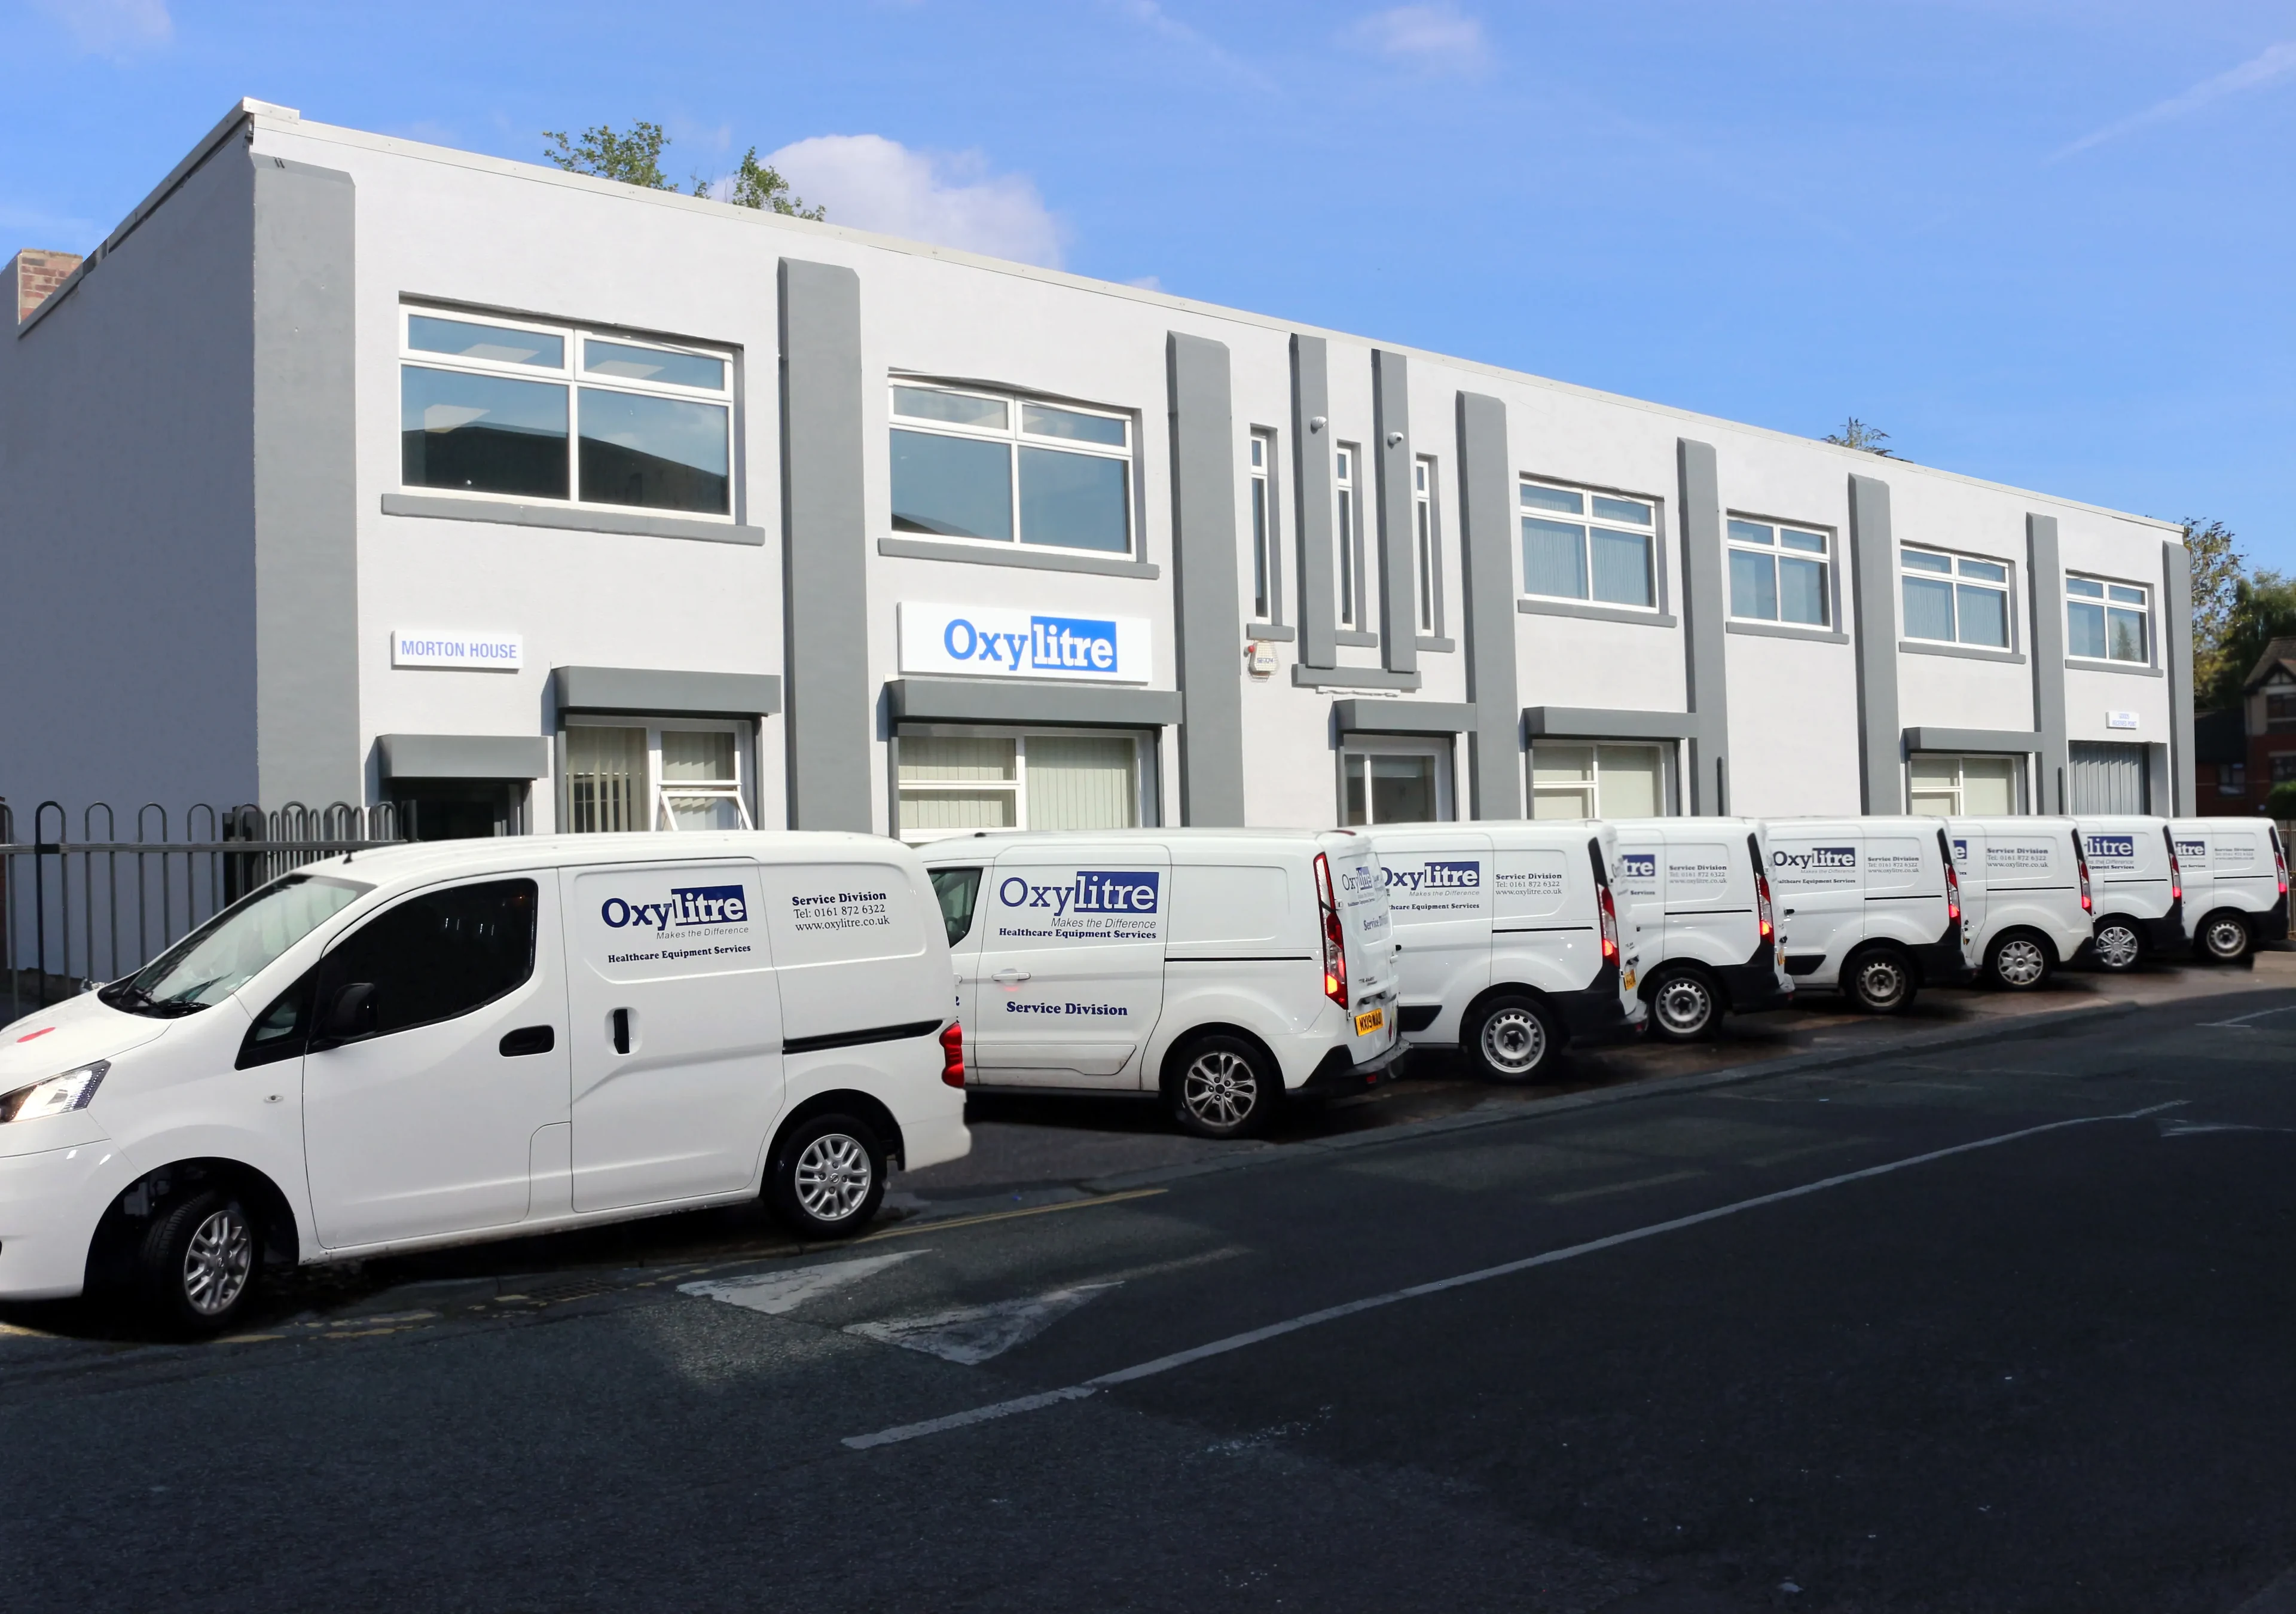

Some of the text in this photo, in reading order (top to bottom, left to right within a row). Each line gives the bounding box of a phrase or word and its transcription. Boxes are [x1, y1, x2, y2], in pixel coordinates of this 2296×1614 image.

[401, 640, 517, 659] MORTON HOUSE
[944, 619, 1113, 671] Oxylitre
[2086, 837, 2132, 855] litre
[1773, 850, 1854, 869] Oxylitre
[792, 891, 887, 906] Service Division
[1000, 876, 1155, 916] Oxylitre
[602, 892, 744, 931] Oxylitre
[793, 904, 885, 919] Tel: 0161 872 6322
[795, 915, 890, 931] www.oxylitre.co.uk
[1051, 918, 1156, 928] Makes the Difference
[657, 931, 685, 940] Makes
[704, 927, 749, 936] Difference
[999, 928, 1156, 939] Healthcare Equipment Services
[608, 945, 751, 963] Healthcare Equipment Services
[1006, 1001, 1128, 1016] Service Division
